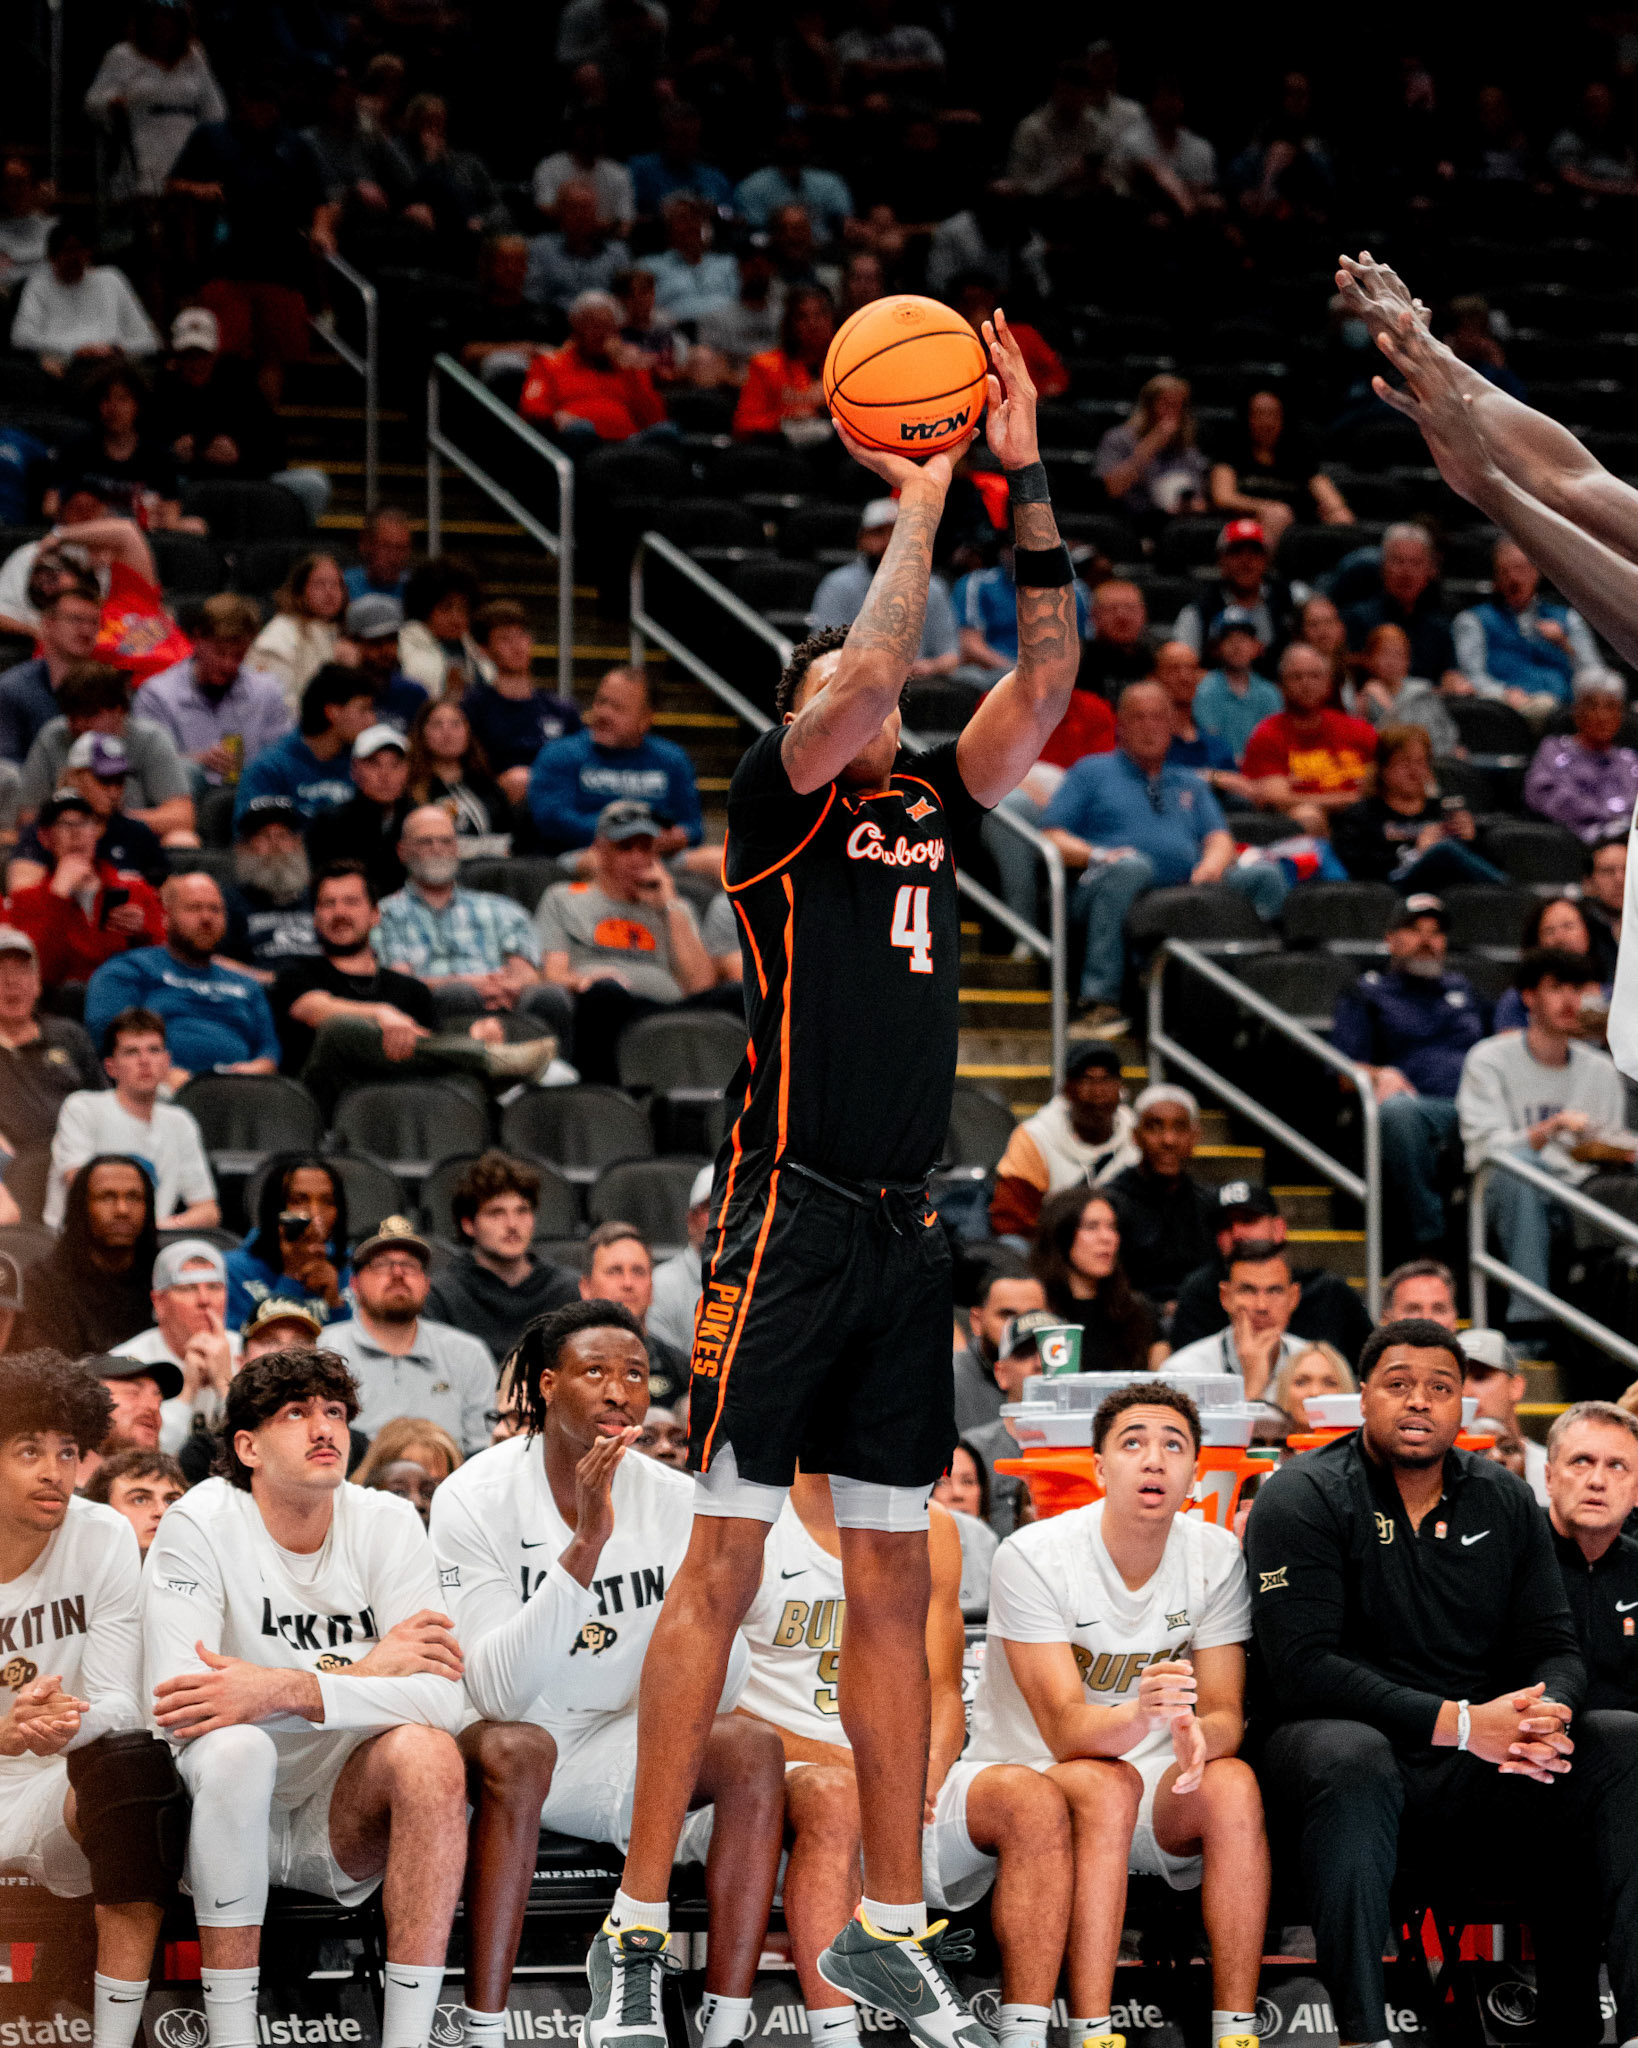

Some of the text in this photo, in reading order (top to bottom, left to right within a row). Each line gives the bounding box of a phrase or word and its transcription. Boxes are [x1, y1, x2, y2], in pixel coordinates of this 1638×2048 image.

[901, 405, 971, 441] NCAA
[890, 885, 934, 975] 4
[693, 1281, 742, 1378] POKES
[1042, 1335, 1069, 1368] G
[630, 1565, 665, 1609] IN
[21, 1604, 45, 1648] IT
[51, 1594, 88, 1640] IN
[261, 1597, 323, 1650] LCK
[534, 1869, 622, 1879] NFEREN
[0, 2012, 92, 2047] state
[256, 2013, 362, 2045] lstate
